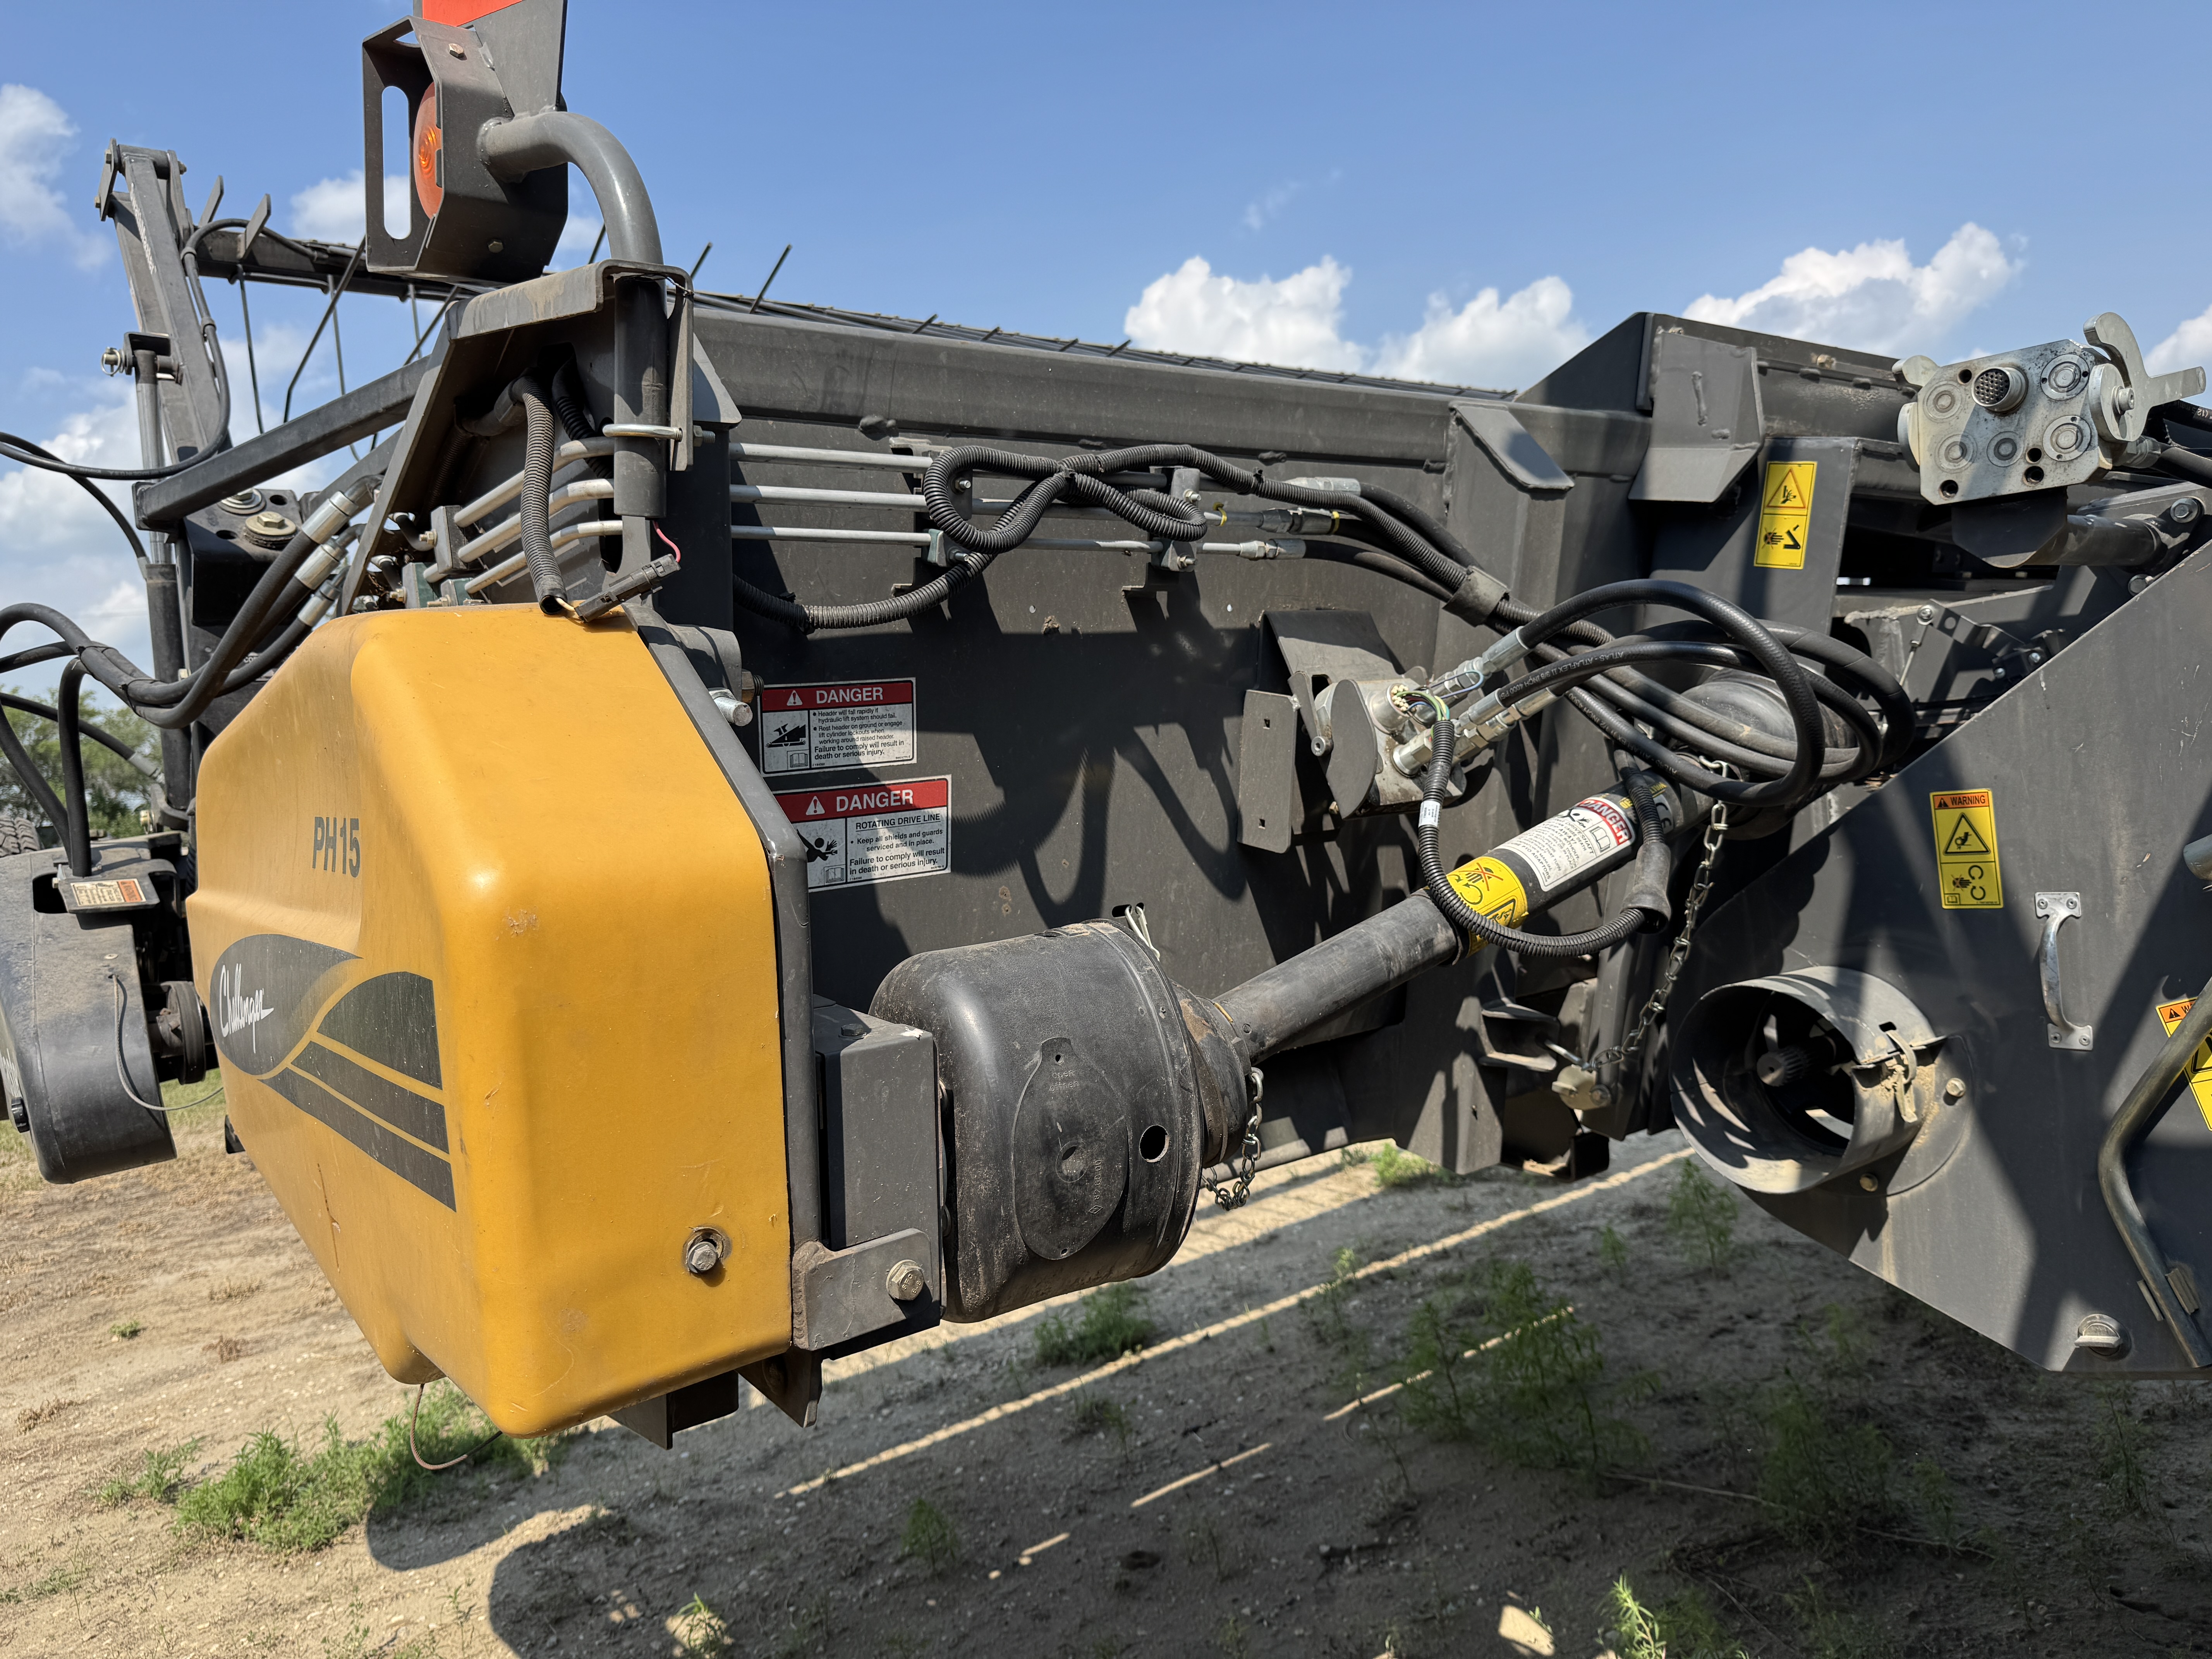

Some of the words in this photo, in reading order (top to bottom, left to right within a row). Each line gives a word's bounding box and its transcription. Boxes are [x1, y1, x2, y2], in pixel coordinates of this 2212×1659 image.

[1599, 651, 1624, 662] ATLAS
[1559, 658, 1593, 674] ATLAFLEX
[816, 687, 883, 704] DANGER
[1510, 684, 1523, 694] 4000
[845, 743, 868, 751] comply
[836, 789, 914, 812] DANGER
[1950, 795, 1985, 806] WARNING
[856, 818, 896, 830] ROTATING
[898, 815, 921, 825] DRIVE
[923, 813, 941, 822] LINE
[1579, 800, 1630, 843] DANGER
[857, 837, 874, 845] Keep
[922, 829, 943, 837] guards
[866, 843, 894, 852] serviced
[916, 838, 934, 848] place.
[312, 816, 361, 878] PH15
[850, 856, 875, 866] Failure
[885, 852, 911, 863] comply
[913, 849, 924, 858] will
[926, 847, 945, 856] result
[858, 865, 879, 874] death
[890, 860, 916, 870] serious
[918, 858, 938, 867] injury.
